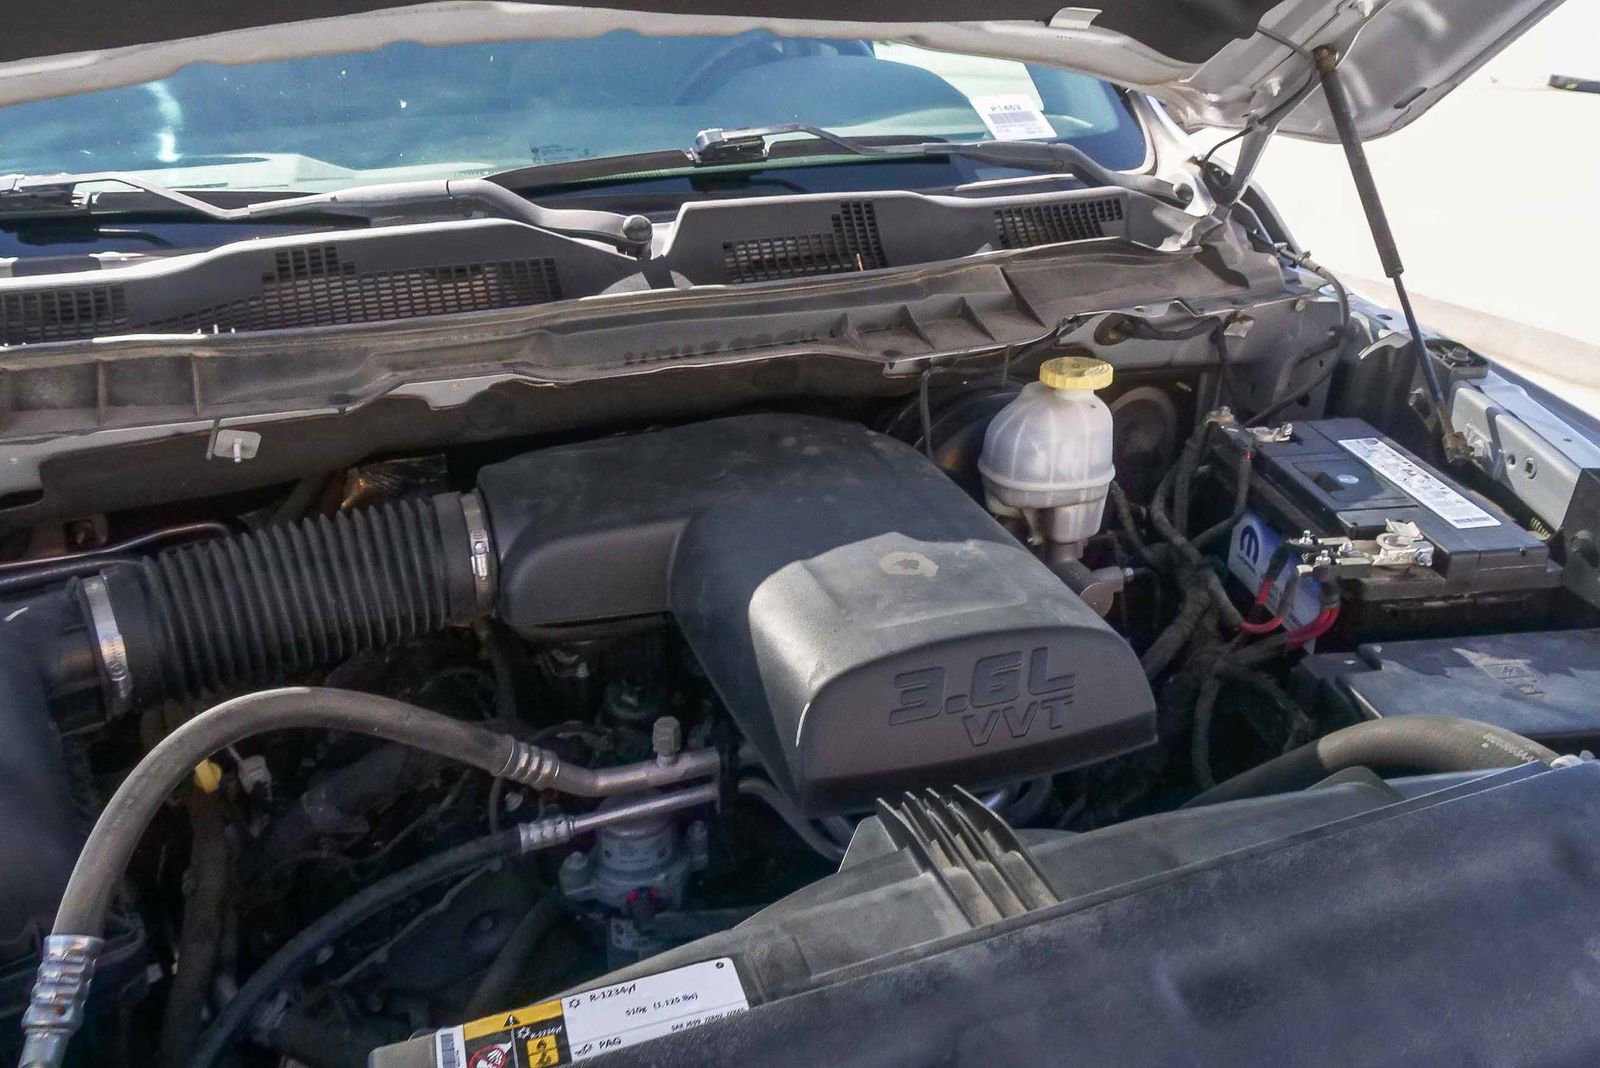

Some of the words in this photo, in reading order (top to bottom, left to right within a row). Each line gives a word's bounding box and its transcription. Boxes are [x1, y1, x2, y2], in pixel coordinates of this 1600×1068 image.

[889, 646, 1075, 726] 3.6L
[962, 694, 1075, 747] VVT
[599, 1036, 622, 1049] PAG
